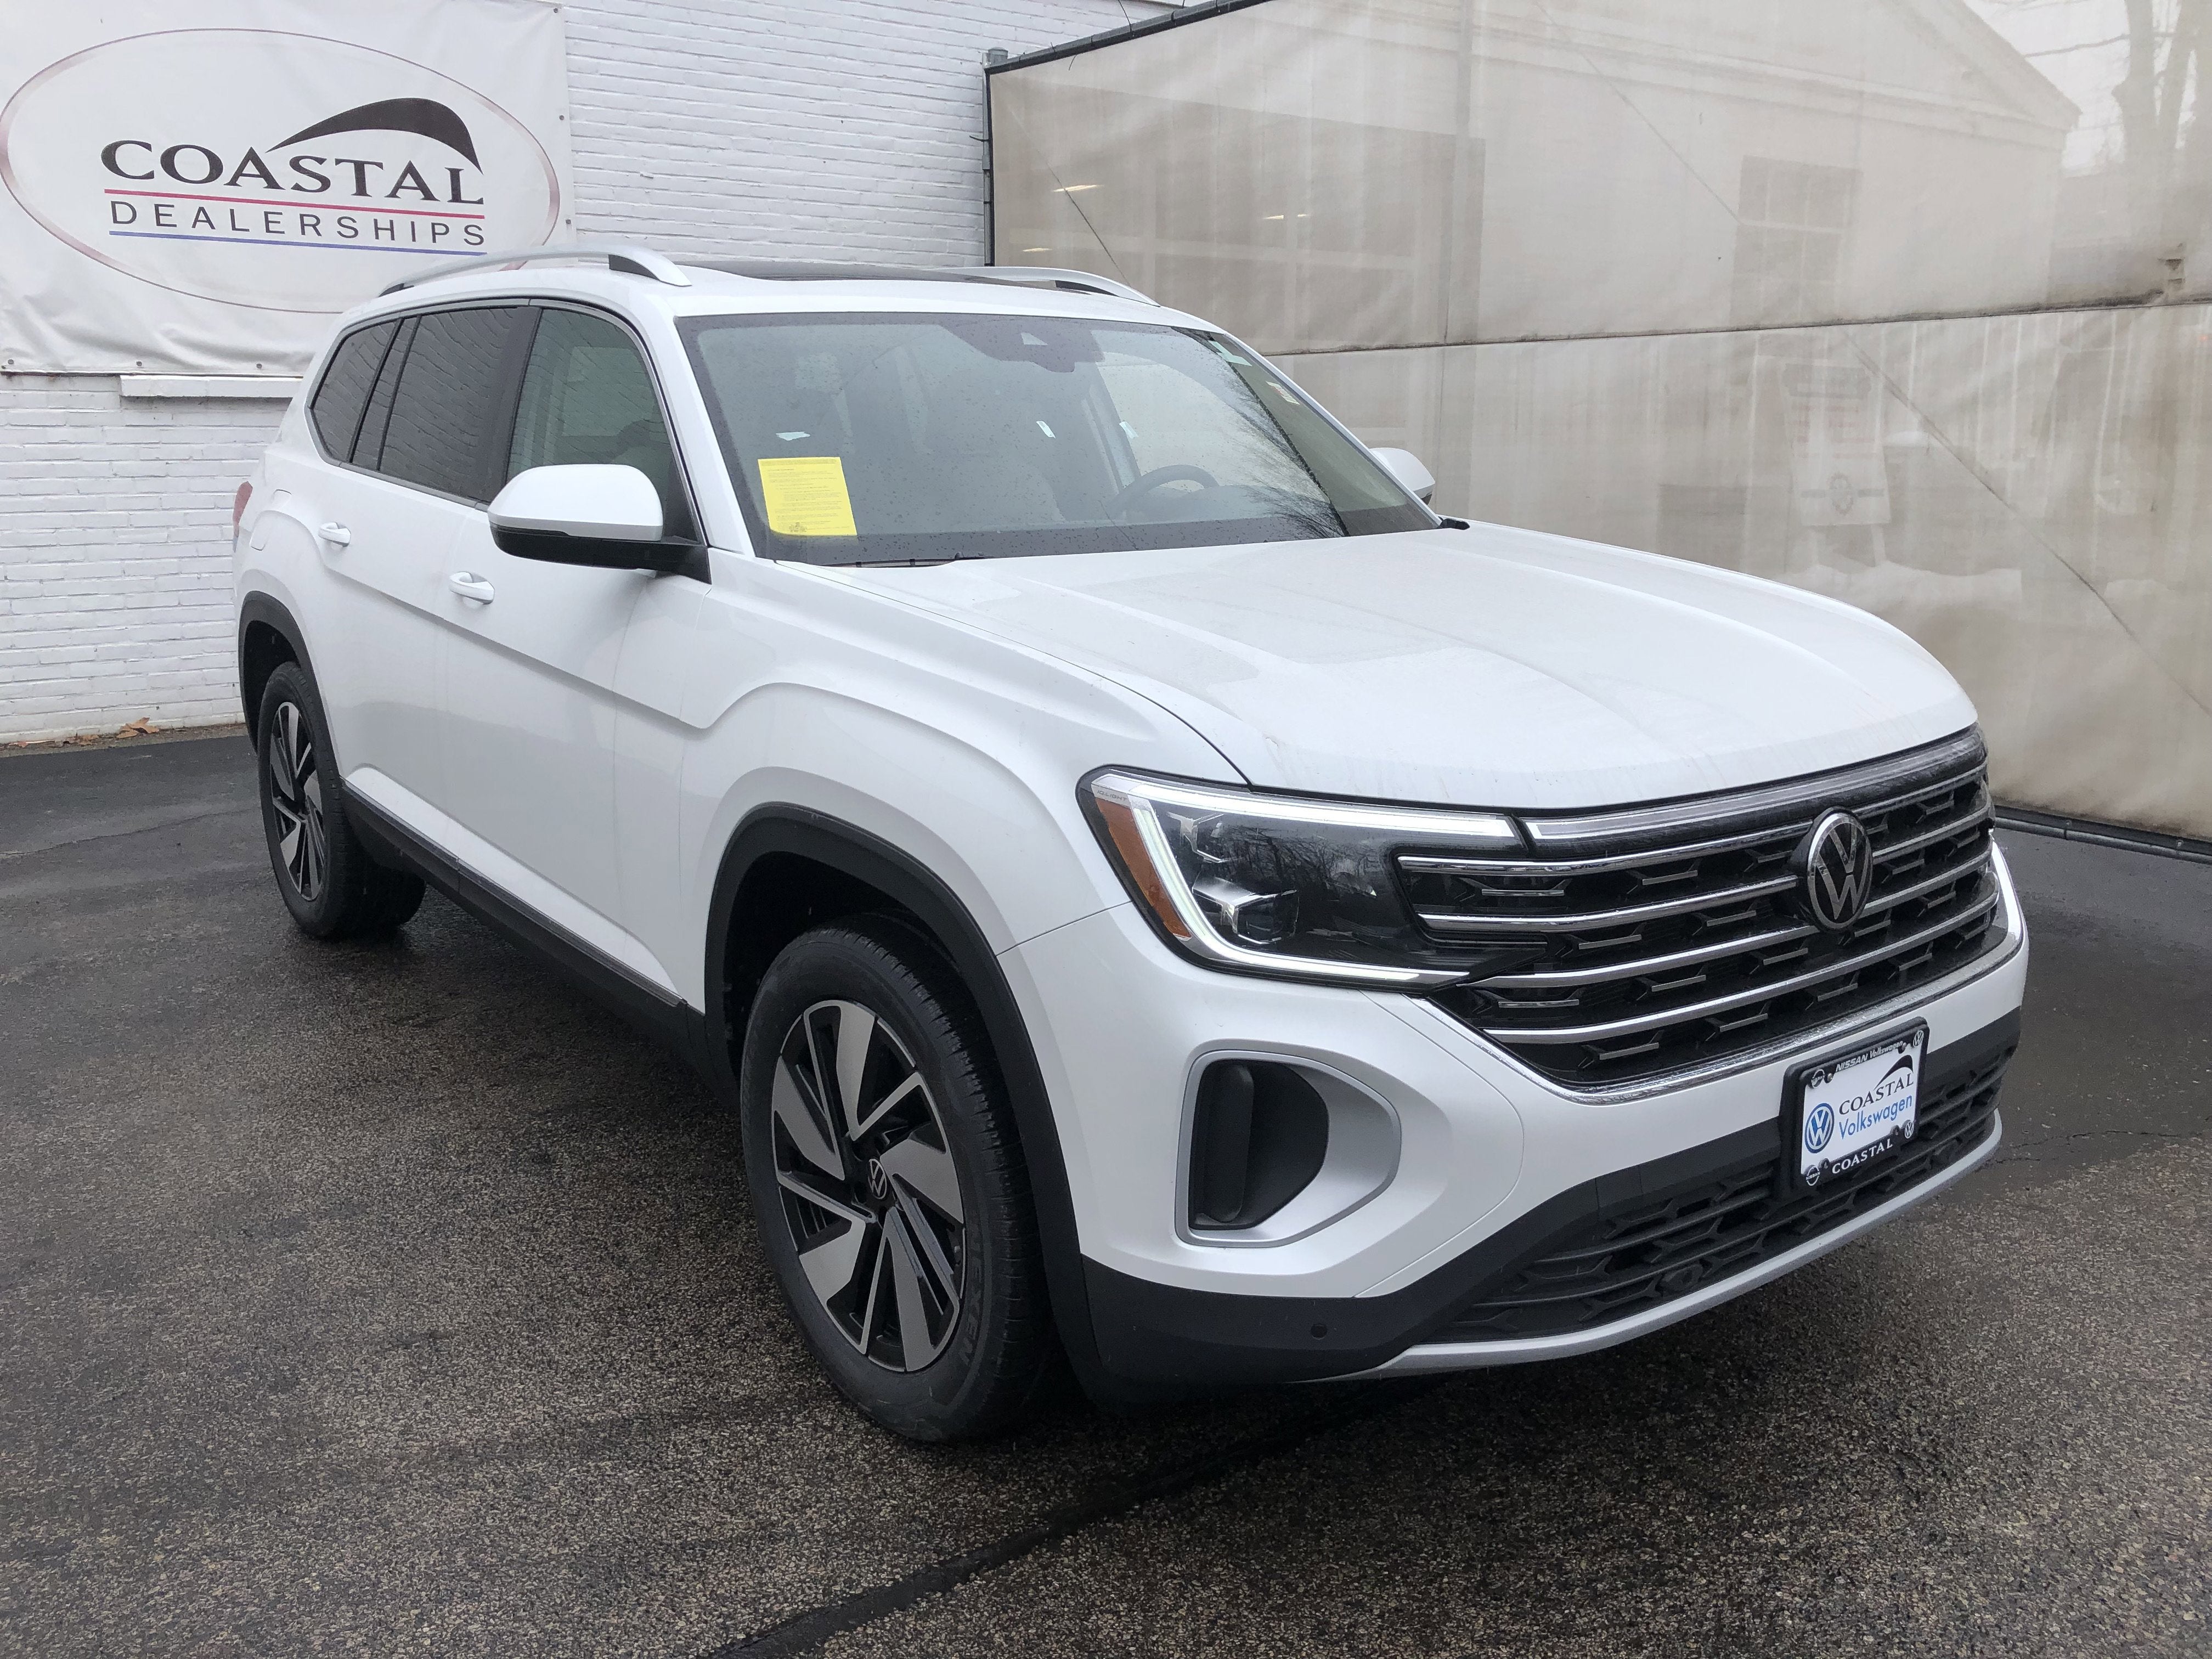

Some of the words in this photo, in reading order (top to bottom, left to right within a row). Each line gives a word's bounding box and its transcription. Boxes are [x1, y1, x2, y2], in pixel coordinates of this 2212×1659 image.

[101, 139, 485, 205] COASTAL
[111, 200, 485, 246] DEALERSHIPS
[1835, 1053, 1868, 1072] NISSAN
[1839, 1073, 1914, 1115] COASTAL
[1838, 1094, 1913, 1140] Volkswagen
[1831, 1138, 1893, 1175] COASTAL
